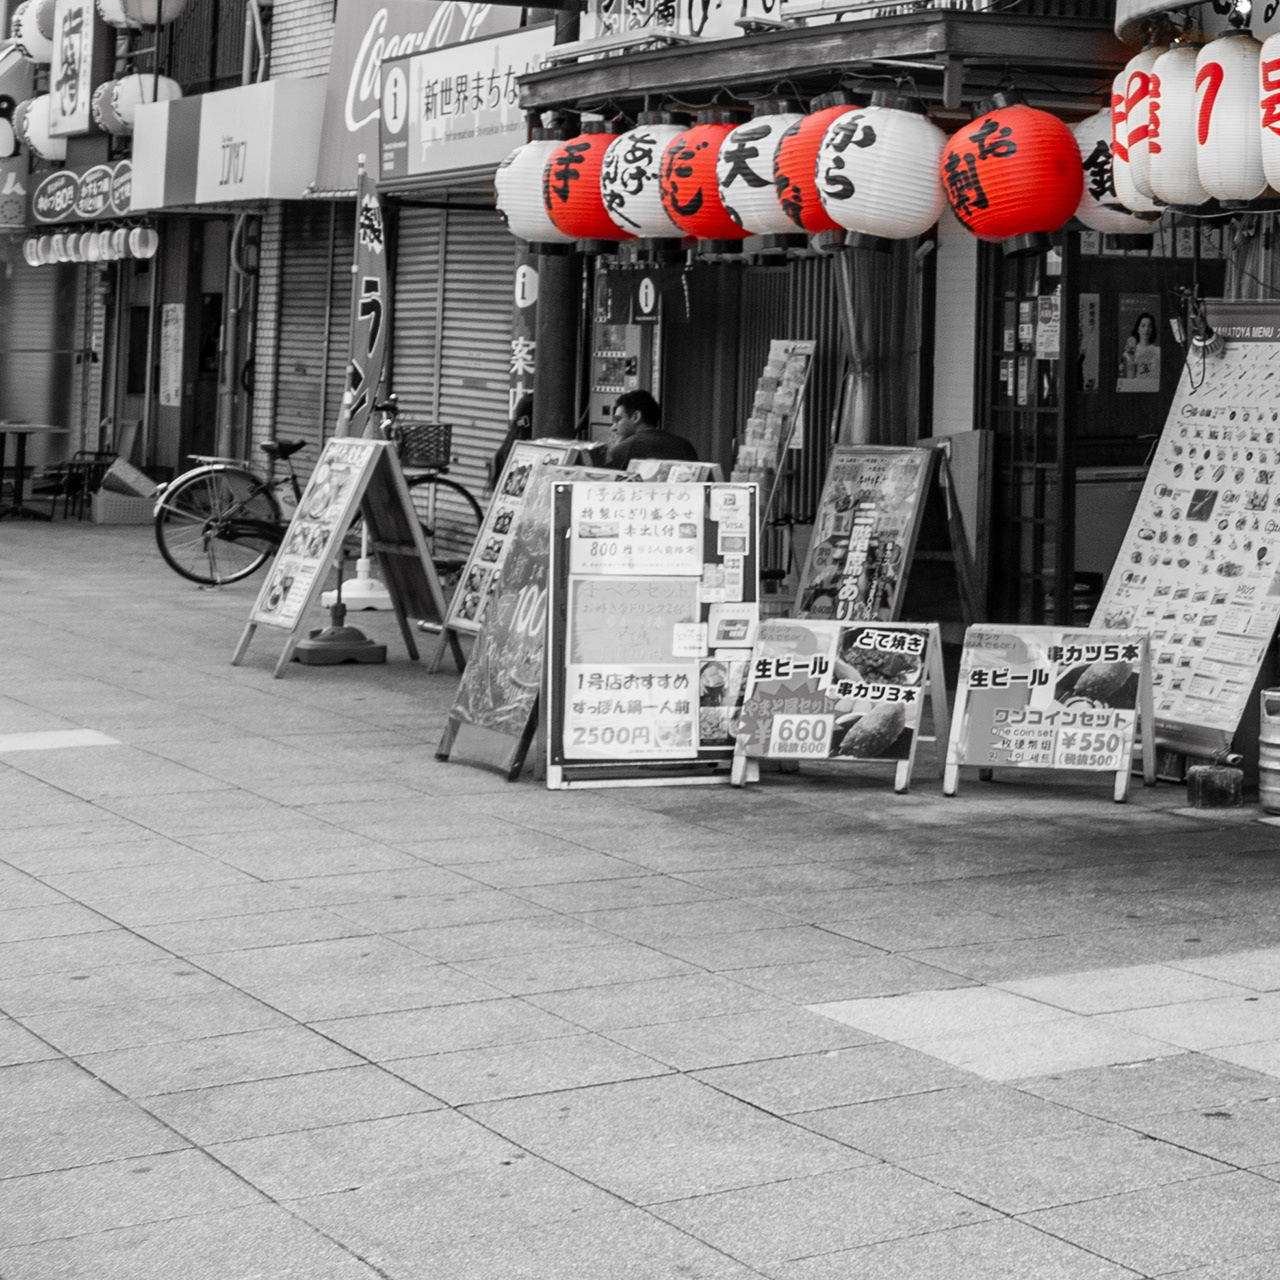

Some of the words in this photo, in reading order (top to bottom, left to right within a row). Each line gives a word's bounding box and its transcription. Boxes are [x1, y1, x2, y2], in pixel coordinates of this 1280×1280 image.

[1252, 326, 1273, 338] MENU
[724, 522, 744, 530] VISA
[859, 629, 925, 653] どて焼き
[1048, 644, 1139, 663] 串カツ5本
[755, 656, 829, 680] 生ビール
[576, 672, 689, 691] 1号店おすすめ
[970, 668, 1049, 689] 生ビール
[838, 682, 917, 703] 串カツ3本
[572, 700, 690, 716] すっぽん鍋一人前
[744, 695, 834, 717] やまと屋セット
[995, 709, 1127, 728] ワンコインセット
[573, 726, 650, 746] 2500円
[990, 726, 1011, 736] One
[1013, 726, 1035, 736] coin
[1037, 727, 1053, 737] set
[1062, 731, 1120, 753] ¥550
